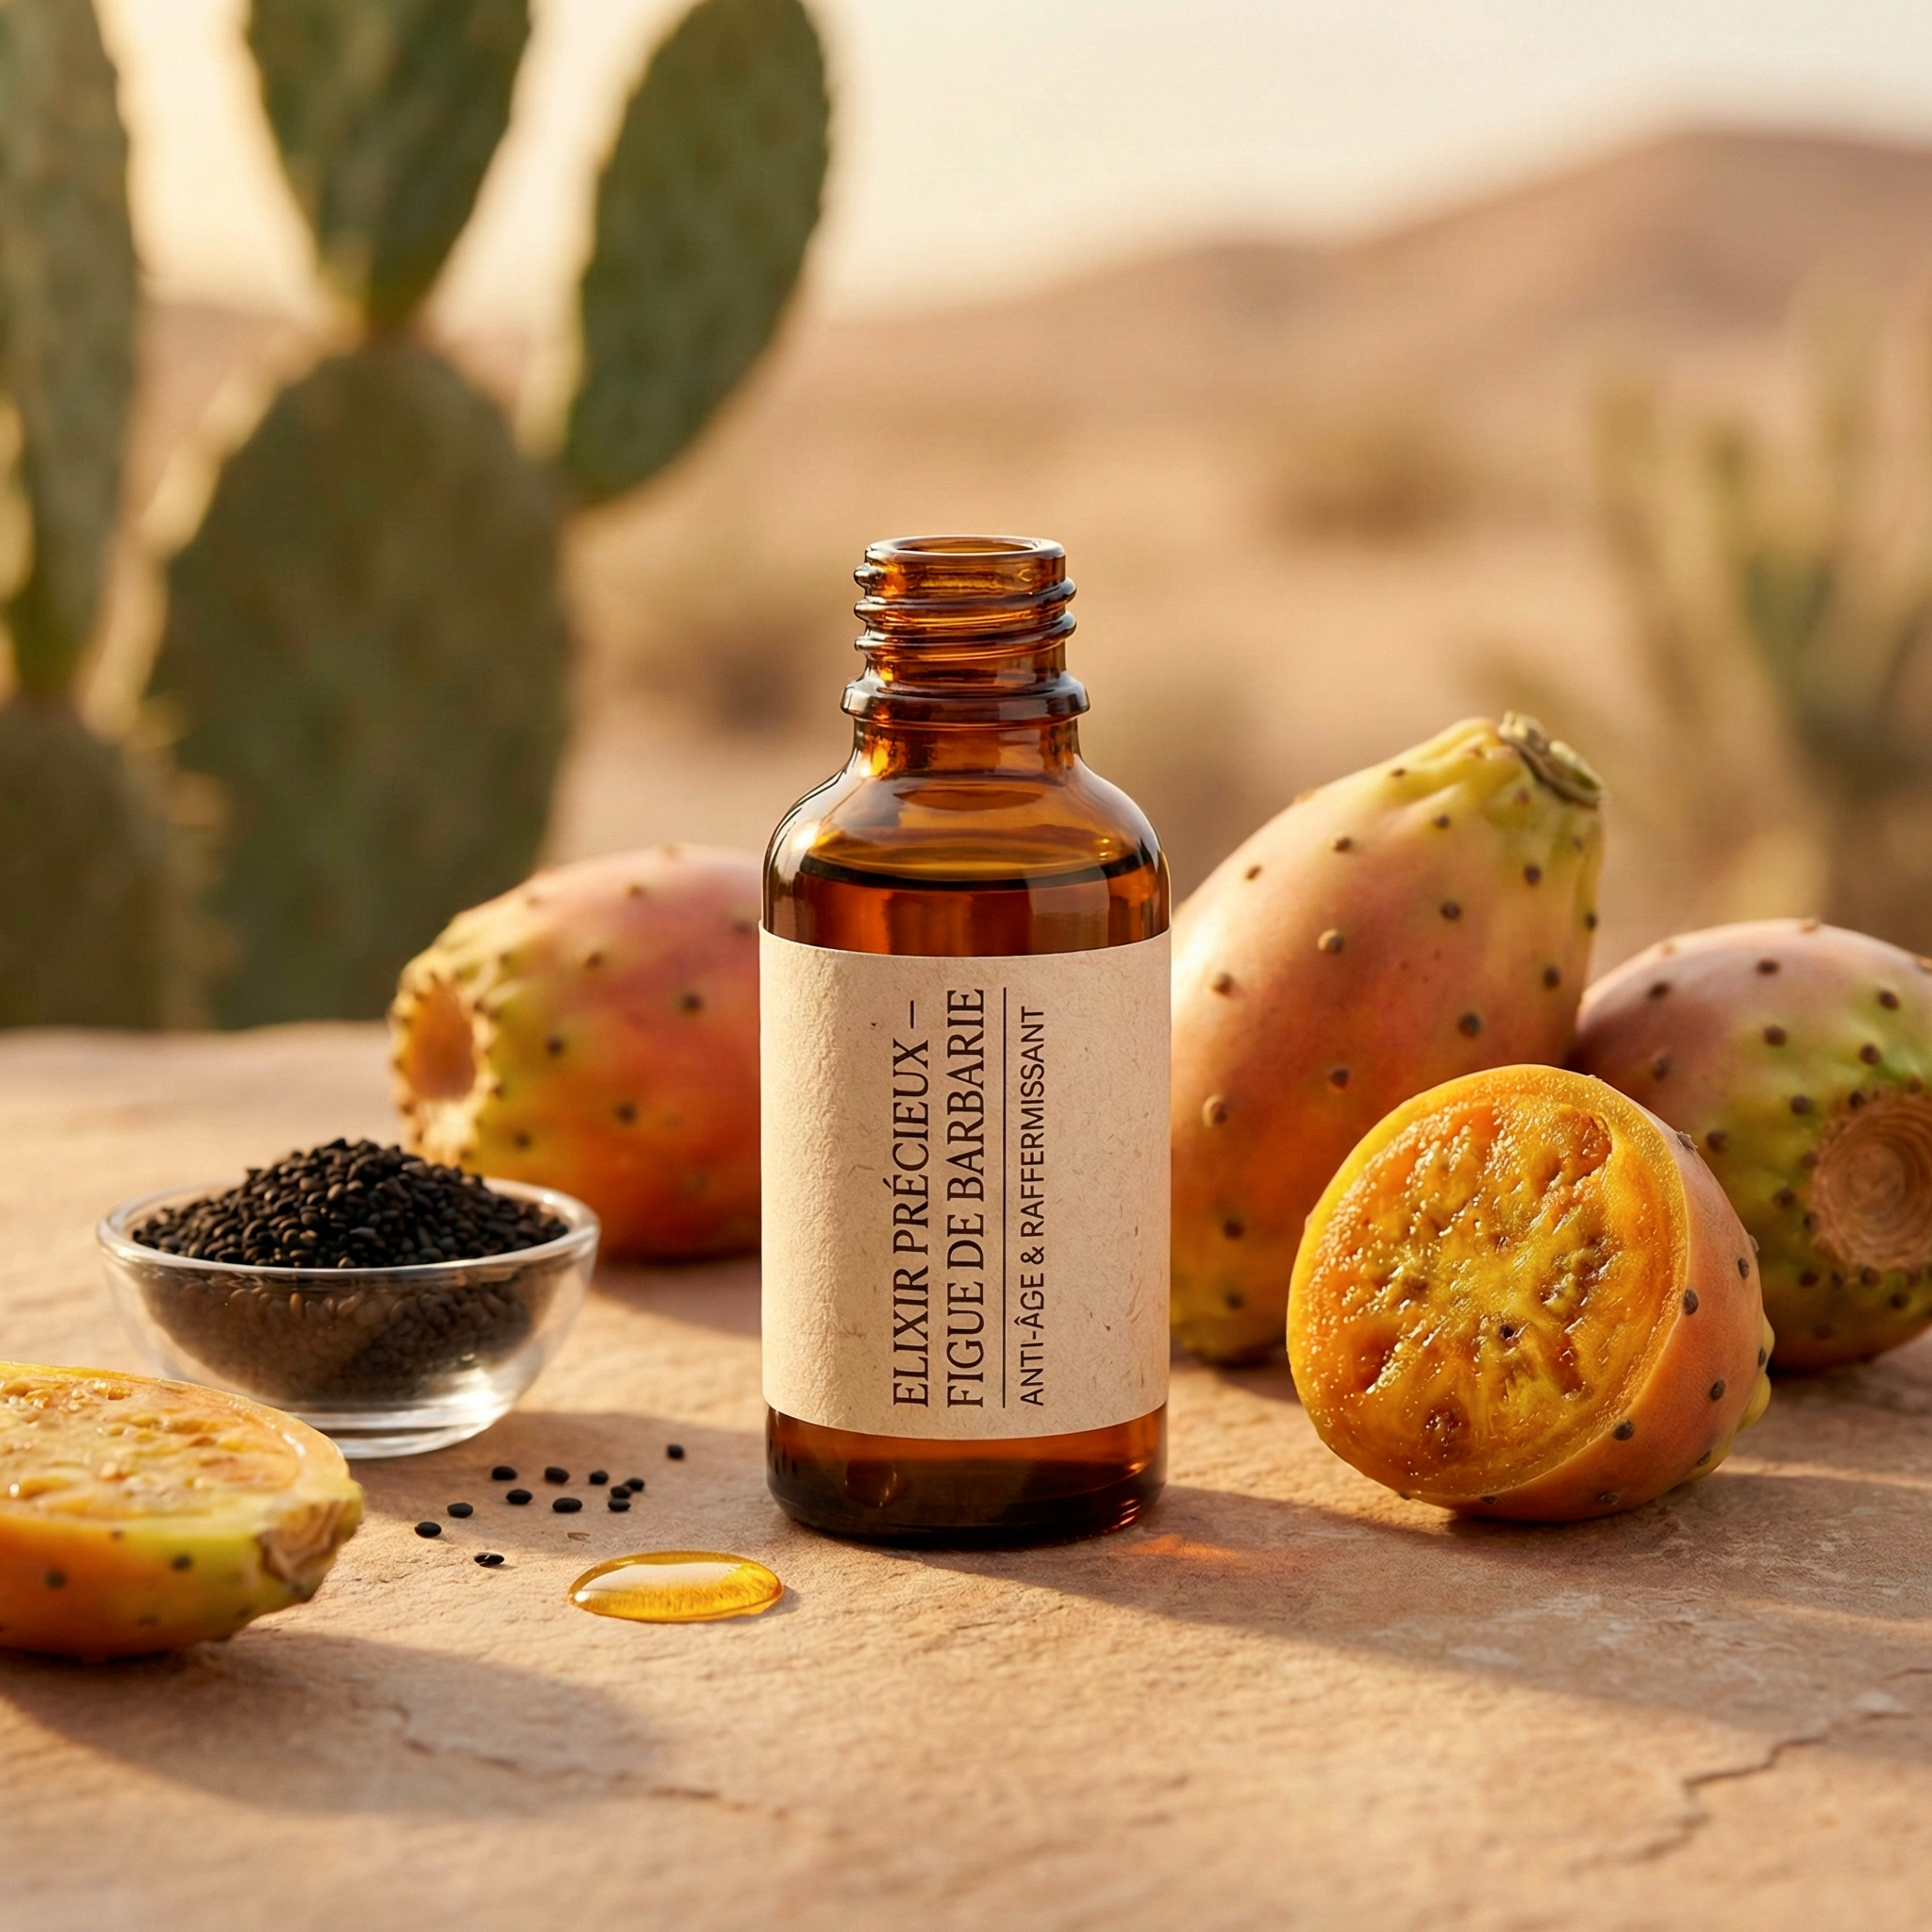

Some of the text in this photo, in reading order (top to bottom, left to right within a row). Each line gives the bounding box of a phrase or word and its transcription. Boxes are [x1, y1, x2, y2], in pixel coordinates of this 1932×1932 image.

[882, 1038, 929, 1256] PRÉCIEUX
[946, 989, 984, 1407] FIGUE DE BARBARIE
[1014, 1006, 1044, 1406] ANTI-ÂGE & RAFFERMISSANT
[892, 1265, 929, 1407] ELIXIR
